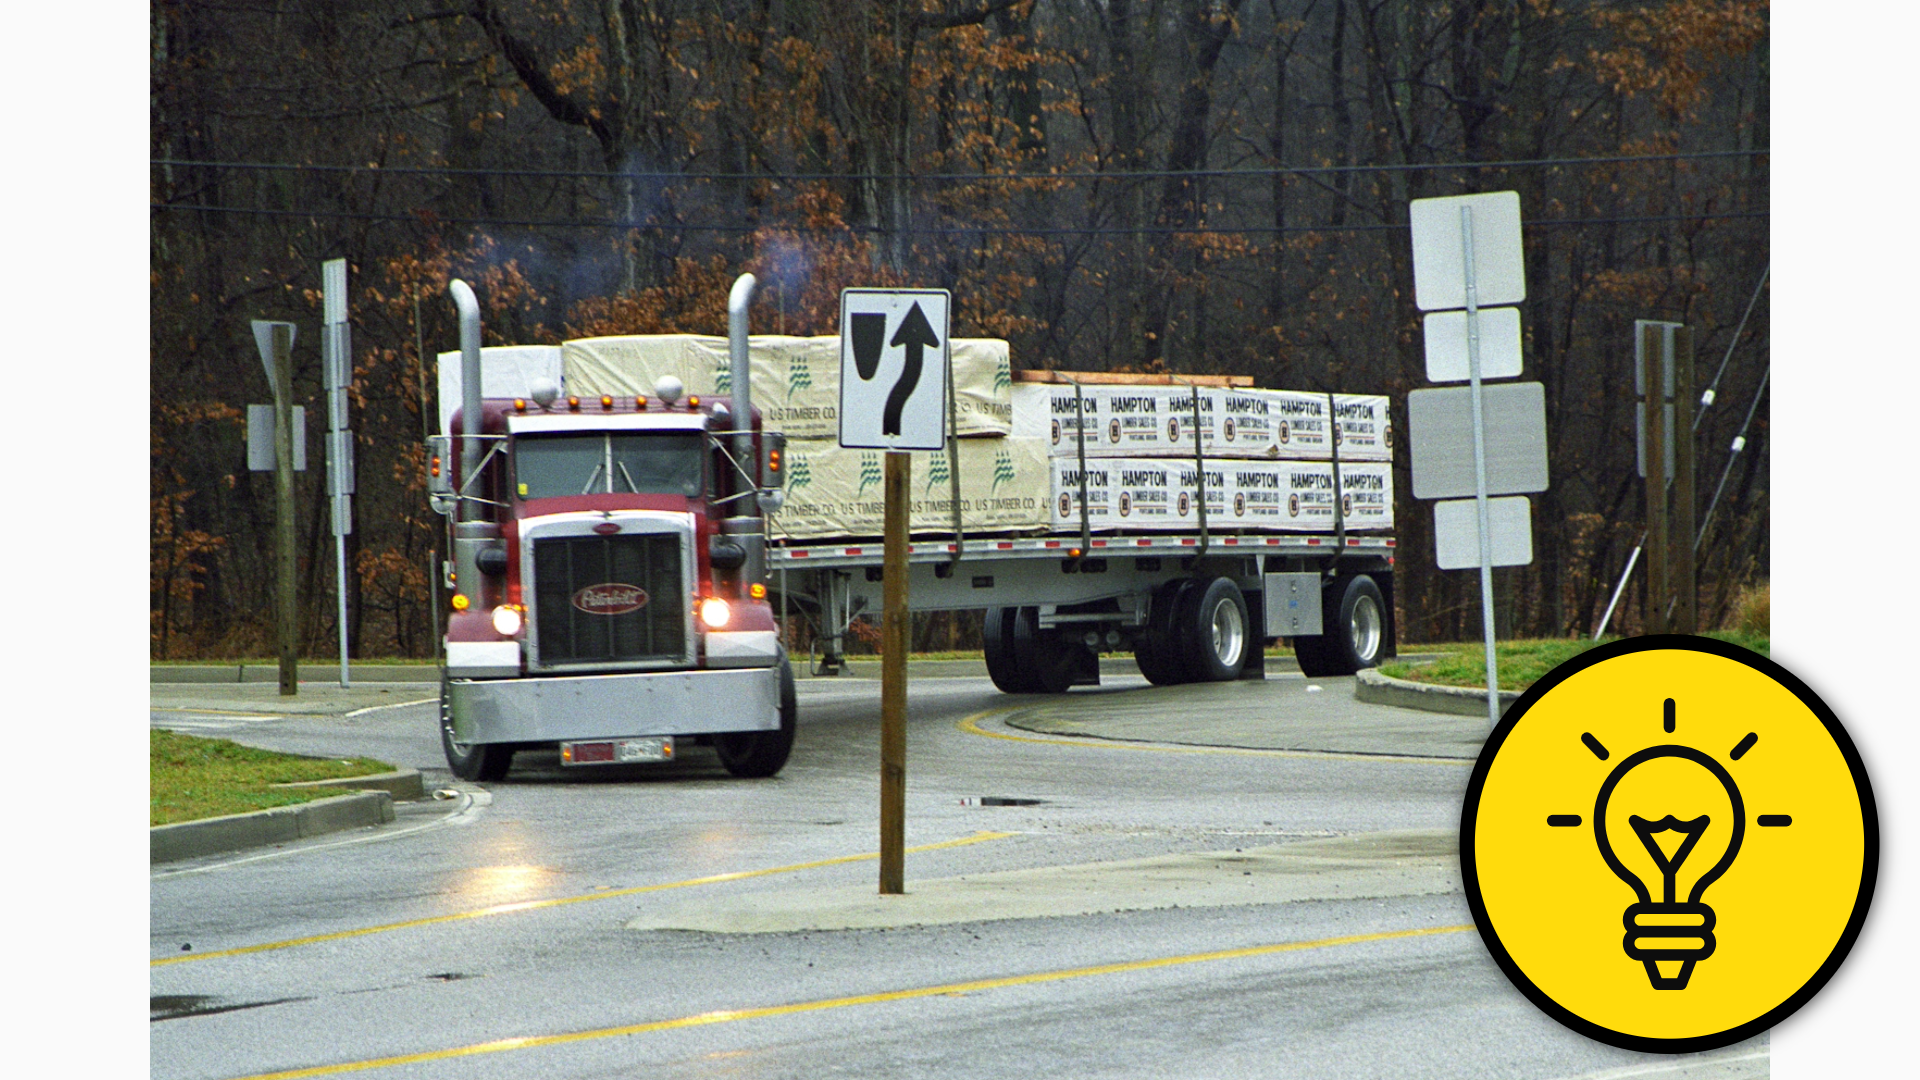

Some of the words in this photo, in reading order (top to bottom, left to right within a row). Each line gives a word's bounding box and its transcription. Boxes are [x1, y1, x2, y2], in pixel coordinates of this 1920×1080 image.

[1051, 397, 1097, 413] HAMPON
[1111, 396, 1156, 413] HAMPTON
[1169, 396, 1213, 412] HAMPON
[1225, 397, 1269, 415] HAMPTON
[1280, 400, 1322, 416] HAMPTON
[785, 406, 821, 420] TIMBER
[1122, 470, 1167, 486] HAMPTON
[1236, 471, 1279, 488] HAMPTON
[1291, 473, 1332, 489] HAMPTON
[1343, 474, 1383, 489] HAMPTON
[783, 504, 820, 517] TIMBER
[856, 502, 885, 514] TIMBE
[925, 500, 953, 512] TIMBE
[990, 498, 1021, 510] TIMBER
